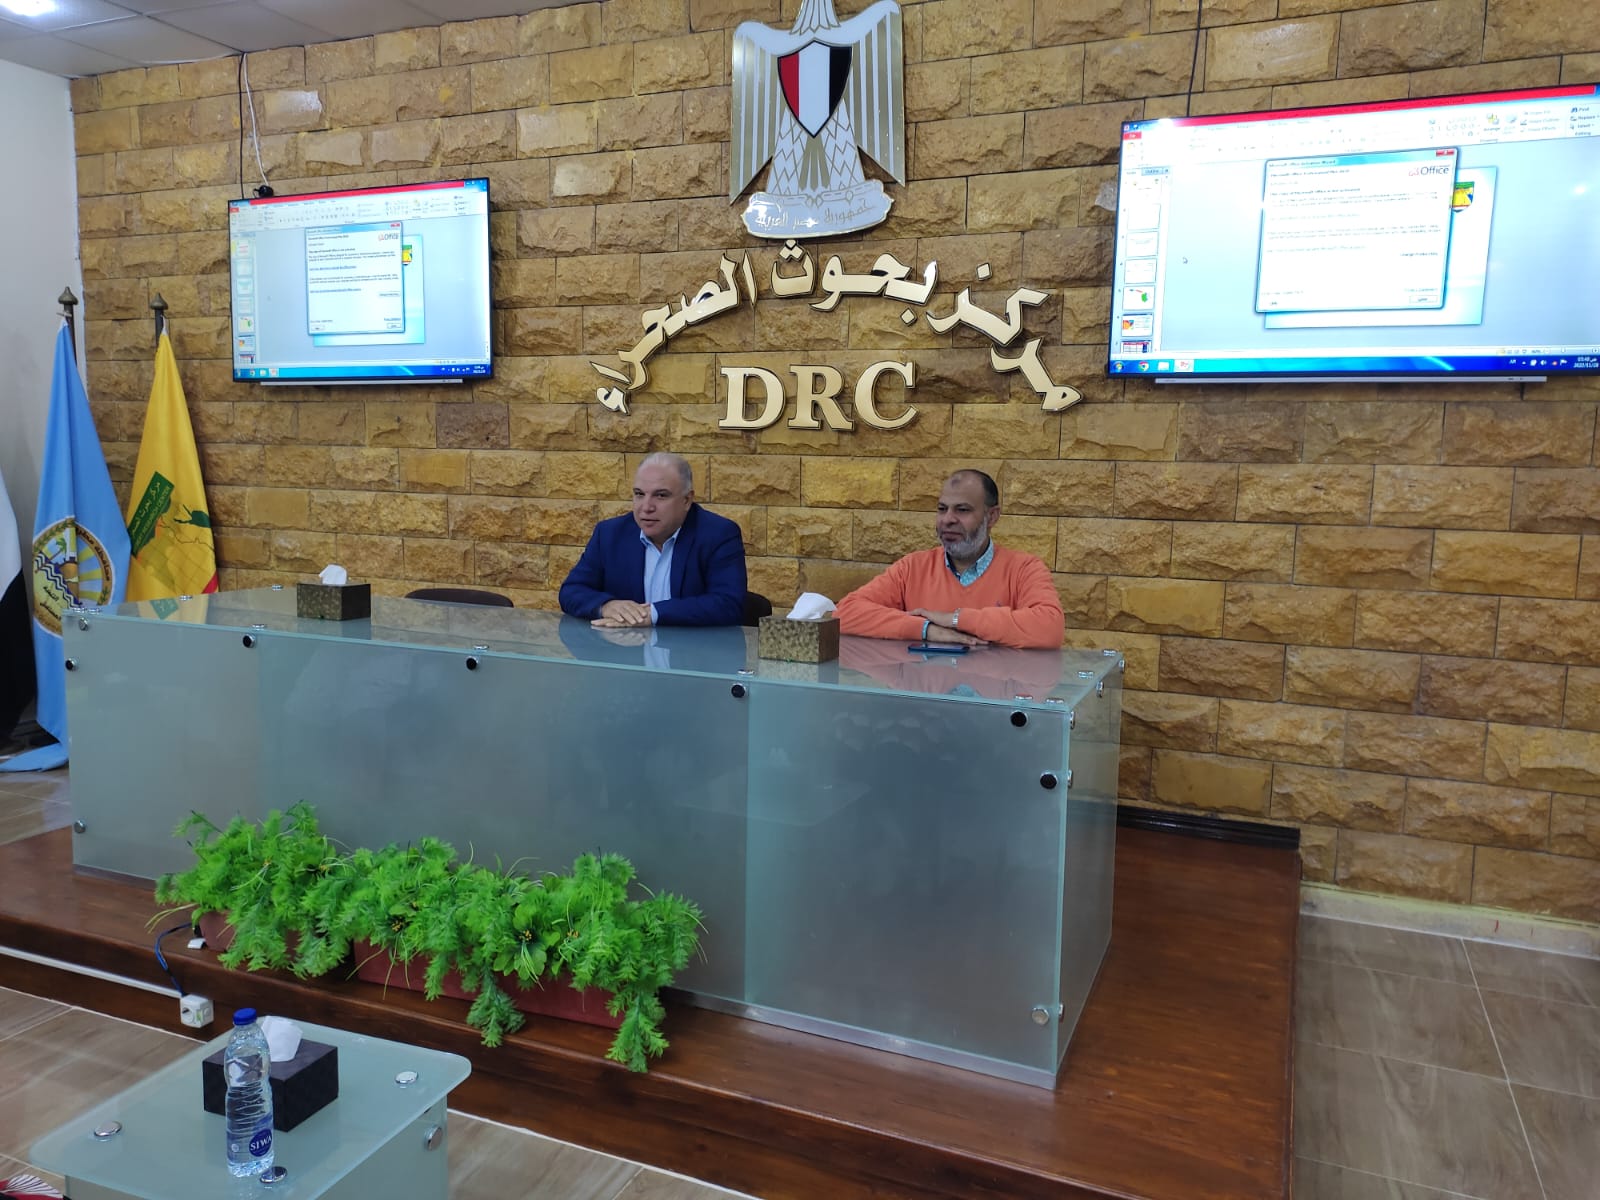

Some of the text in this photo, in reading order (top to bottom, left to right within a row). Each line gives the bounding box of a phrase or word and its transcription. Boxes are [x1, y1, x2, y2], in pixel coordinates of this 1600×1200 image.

[1420, 166, 1450, 177] Office
[770, 238, 939, 327] بحوث
[926, 261, 1083, 412] مركز
[718, 360, 920, 431] DRC
[250, 1135, 272, 1151] SIWA
